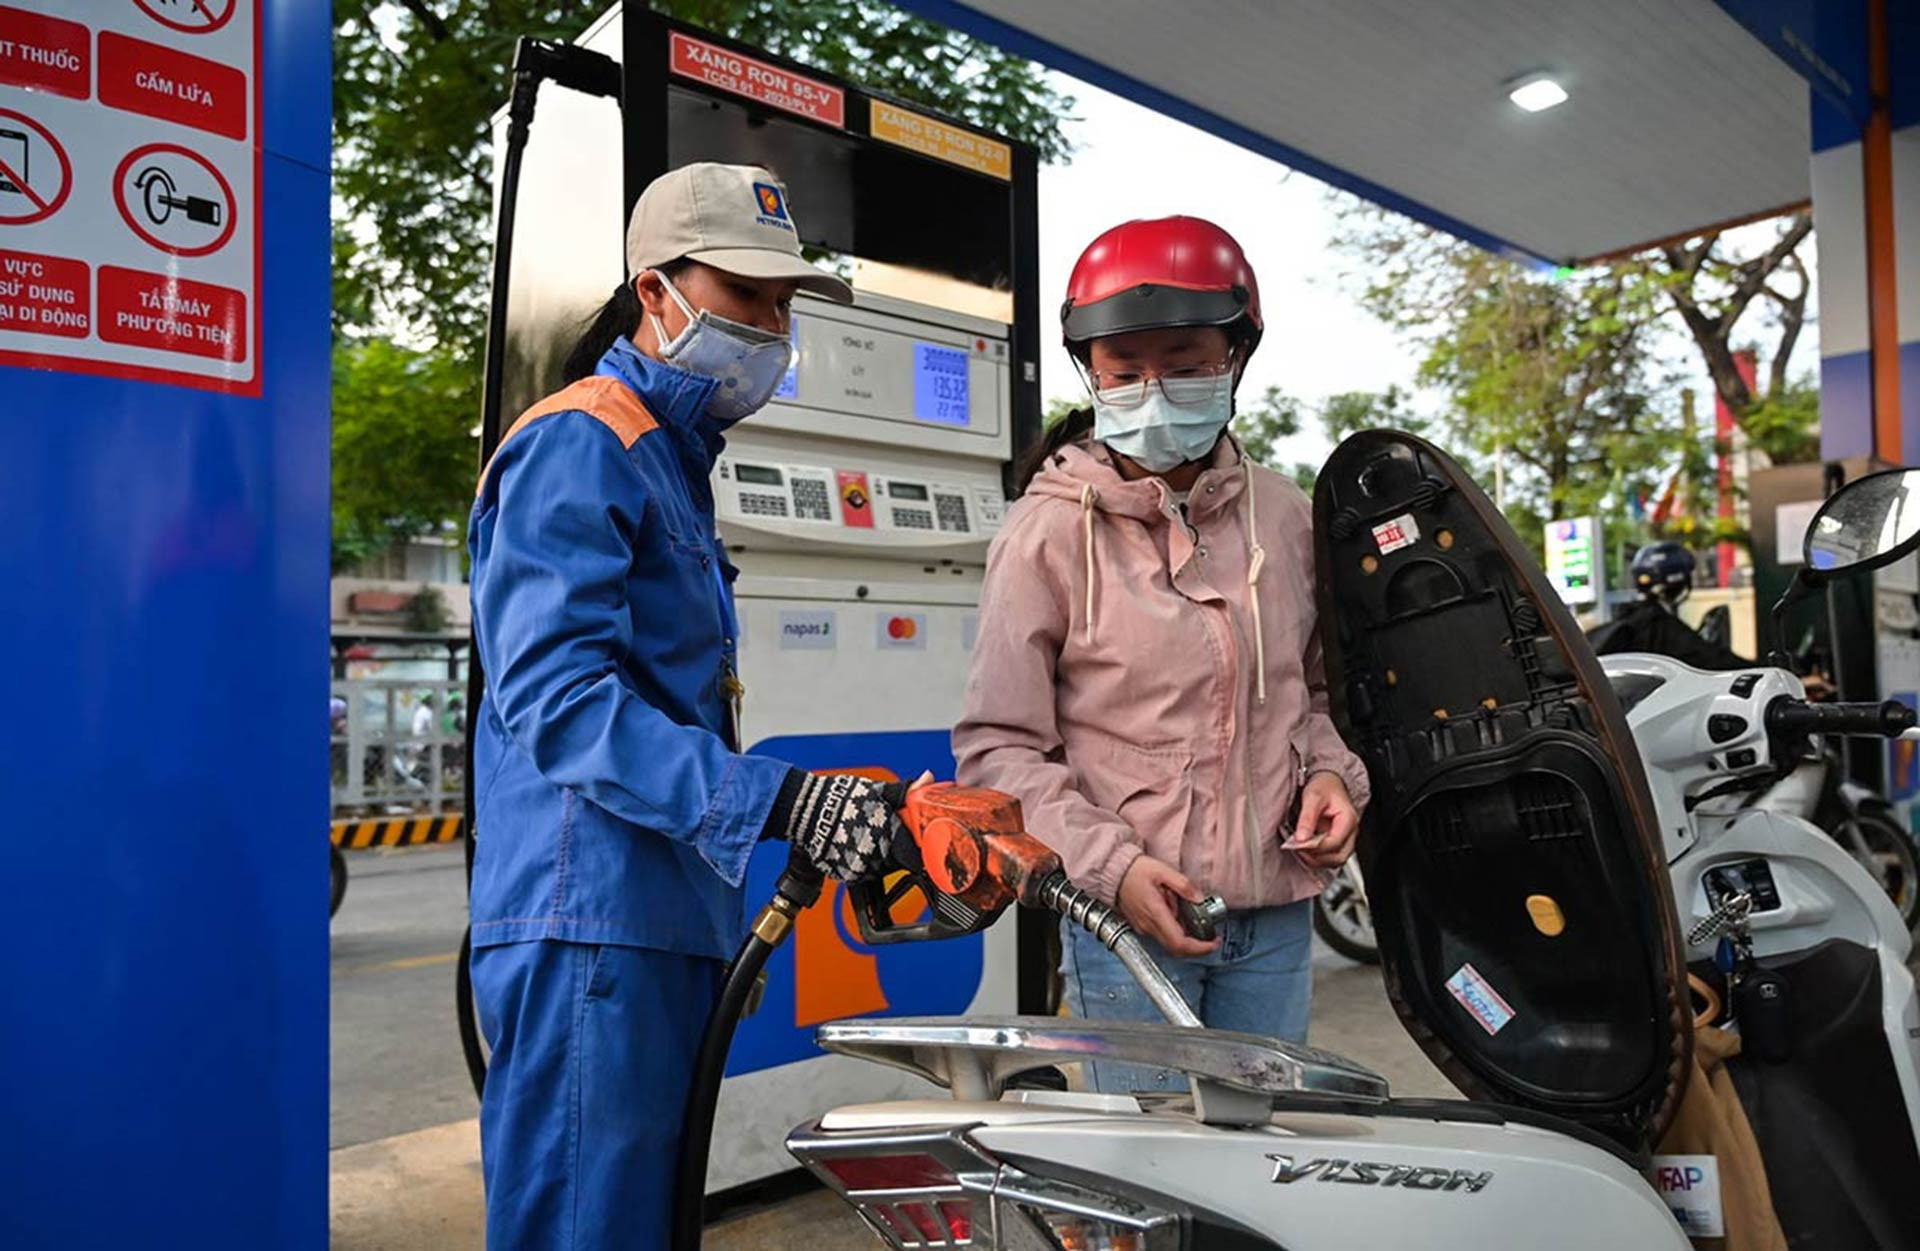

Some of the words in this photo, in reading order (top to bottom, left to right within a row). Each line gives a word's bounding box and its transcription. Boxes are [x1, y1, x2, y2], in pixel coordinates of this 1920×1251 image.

[19, 44, 80, 72] THUỐC
[136, 71, 173, 95] CẤM
[178, 83, 213, 106] LỬA
[702, 68, 737, 90] TCCS
[748, 64, 788, 91] RON
[793, 82, 831, 106] 95-V
[4, 259, 43, 278] VỰC
[29, 285, 75, 304] DỤNG
[20, 306, 36, 321] DI
[42, 307, 87, 328] ĐỘNG
[117, 311, 193, 337] PHƯƠNG
[196, 324, 232, 345] TIỆN
[1264, 1153, 1495, 1193] VISION
